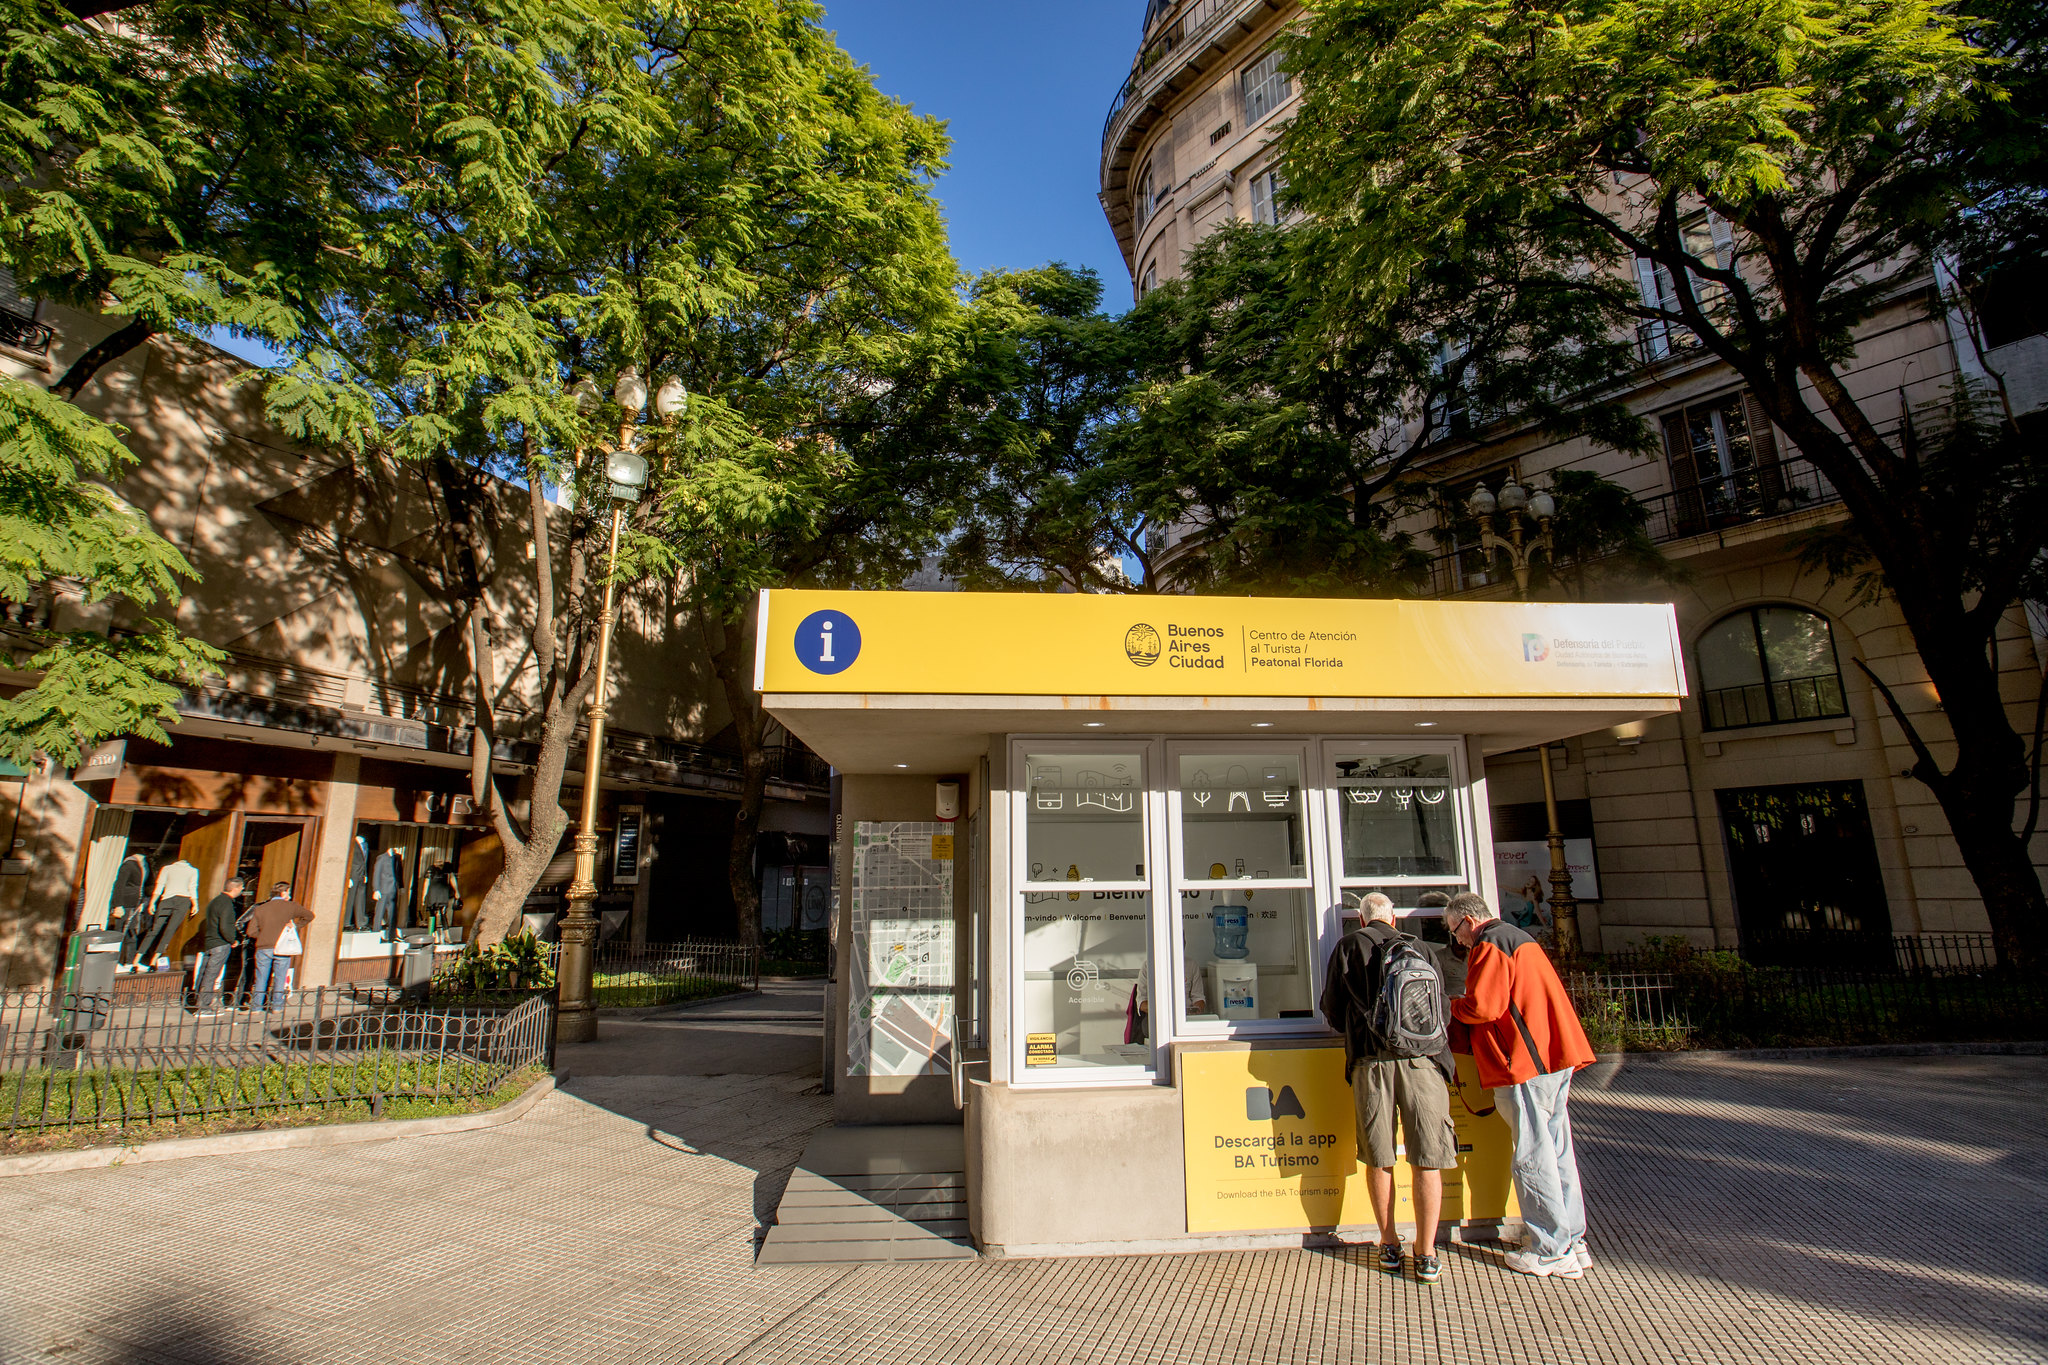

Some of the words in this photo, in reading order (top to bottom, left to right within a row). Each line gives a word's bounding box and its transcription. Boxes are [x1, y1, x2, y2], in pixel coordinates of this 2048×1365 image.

[1167, 624, 1225, 638] Buenos
[1249, 629, 1288, 641] Centro
[1290, 630, 1306, 641] de
[1308, 630, 1357, 641] Atención
[1168, 639, 1211, 653] Aires
[1250, 643, 1260, 653] al
[1264, 643, 1301, 654] Turista
[1553, 638, 1600, 649] Defensoría
[1601, 638, 1615, 649] del
[1169, 655, 1225, 668] Ciudad
[1251, 656, 1301, 668] Peatonal
[1304, 657, 1344, 668] Florida
[1065, 913, 1102, 921] Welcome
[1109, 913, 1146, 921] Benvenut
[1214, 1132, 1285, 1151] Descargá
[1290, 1131, 1304, 1146] la
[1308, 1134, 1337, 1148] app
[1234, 1155, 1255, 1168] BA
[1260, 1153, 1320, 1168] Turismo
[1217, 1190, 1258, 1200] Download
[1260, 1189, 1273, 1198] the
[1275, 1189, 1287, 1197] BA
[1289, 1187, 1321, 1197] Tourism
[1323, 1187, 1340, 1197] app
